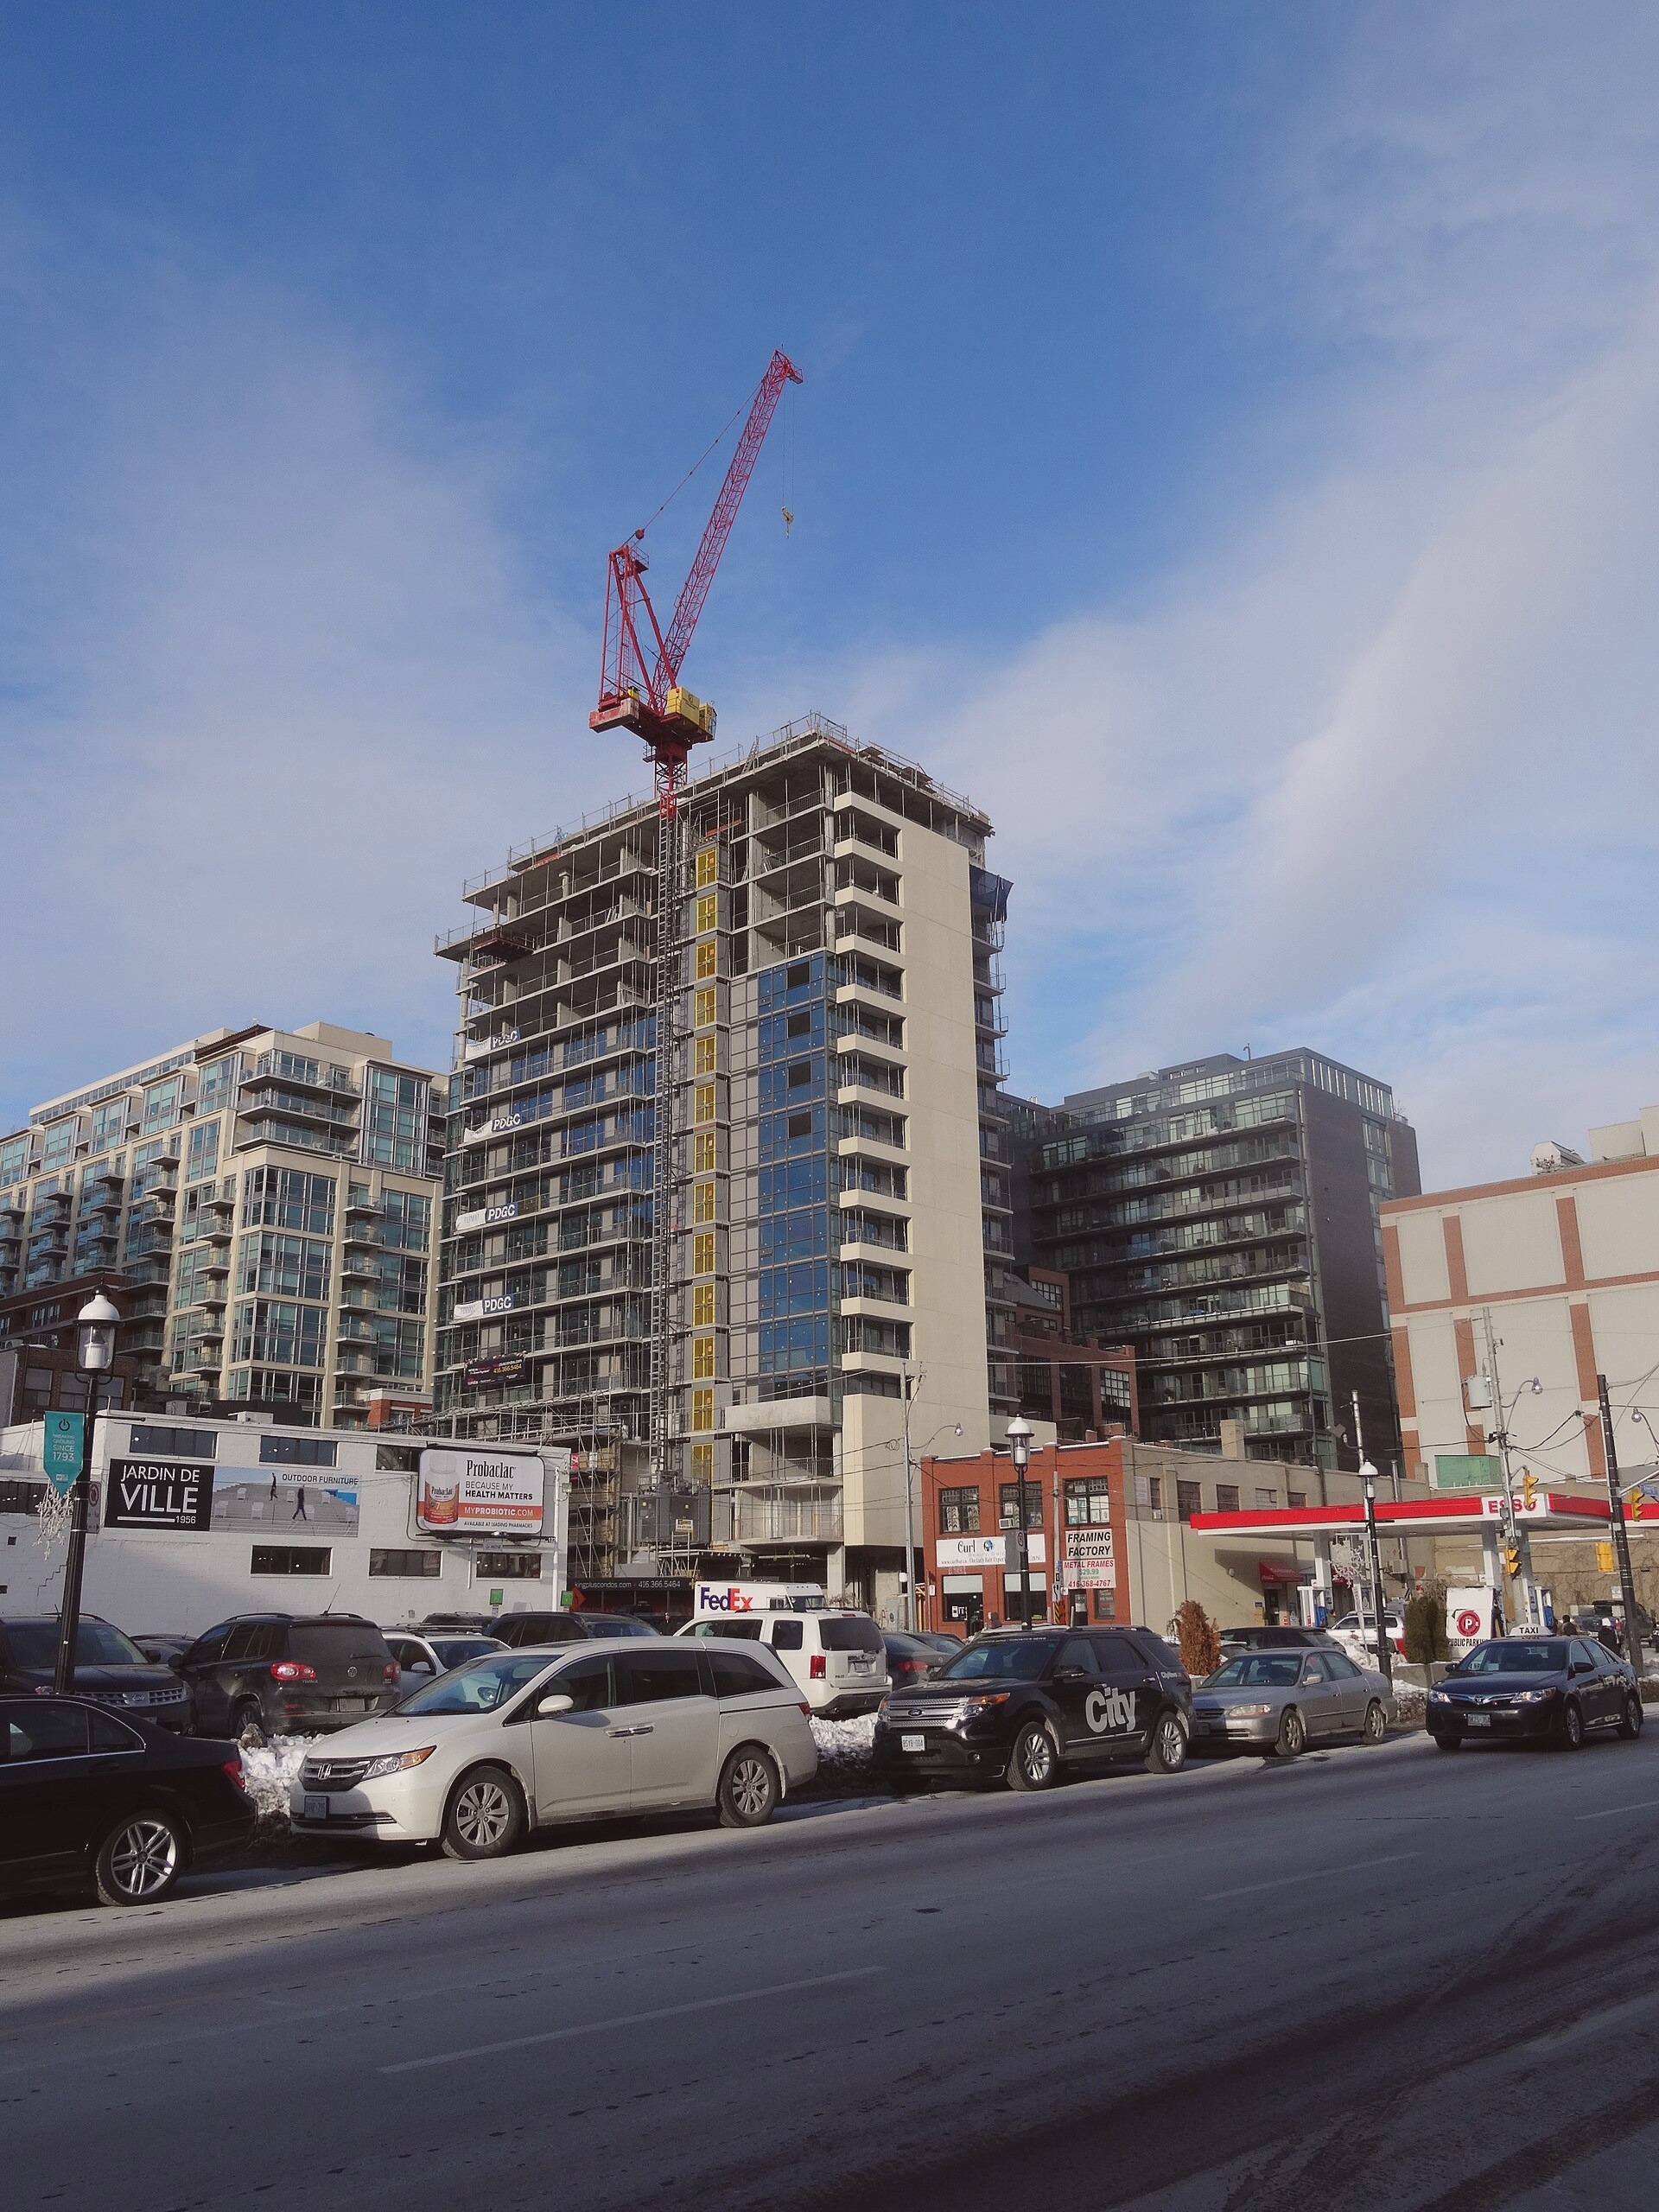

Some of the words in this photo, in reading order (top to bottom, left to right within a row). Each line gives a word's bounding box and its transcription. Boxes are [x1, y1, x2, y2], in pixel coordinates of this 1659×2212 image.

[493, 1113, 520, 1131] PDGC
[487, 1204, 516, 1221] PDGC
[484, 1296, 512, 1313] PDGC
[53, 1452, 74, 1461] 1793
[121, 1465, 175, 1482] JARDIN
[180, 1469, 200, 1483] DE
[467, 1459, 514, 1478] Probaclac
[282, 1473, 318, 1483] OUTDOOR
[319, 1476, 359, 1485] FURNITURE
[465, 1480, 500, 1490] BECAUSE
[120, 1483, 199, 1514] VILLE
[465, 1490, 496, 1498] HEALTH
[498, 1491, 533, 1500] MATTERS
[464, 1506, 533, 1516] MYPROBIOTIC.COM
[1488, 1498, 1536, 1514] ESO
[175, 1516, 196, 1524] 1956
[1067, 1531, 1111, 1543] FRAMING
[957, 1539, 976, 1554] Curl
[1068, 1545, 1111, 1556] FACTORY
[575, 1581, 632, 1590] kingpluscondos.com
[700, 1586, 753, 1611] FedEx
[1085, 1687, 1135, 1732] City
